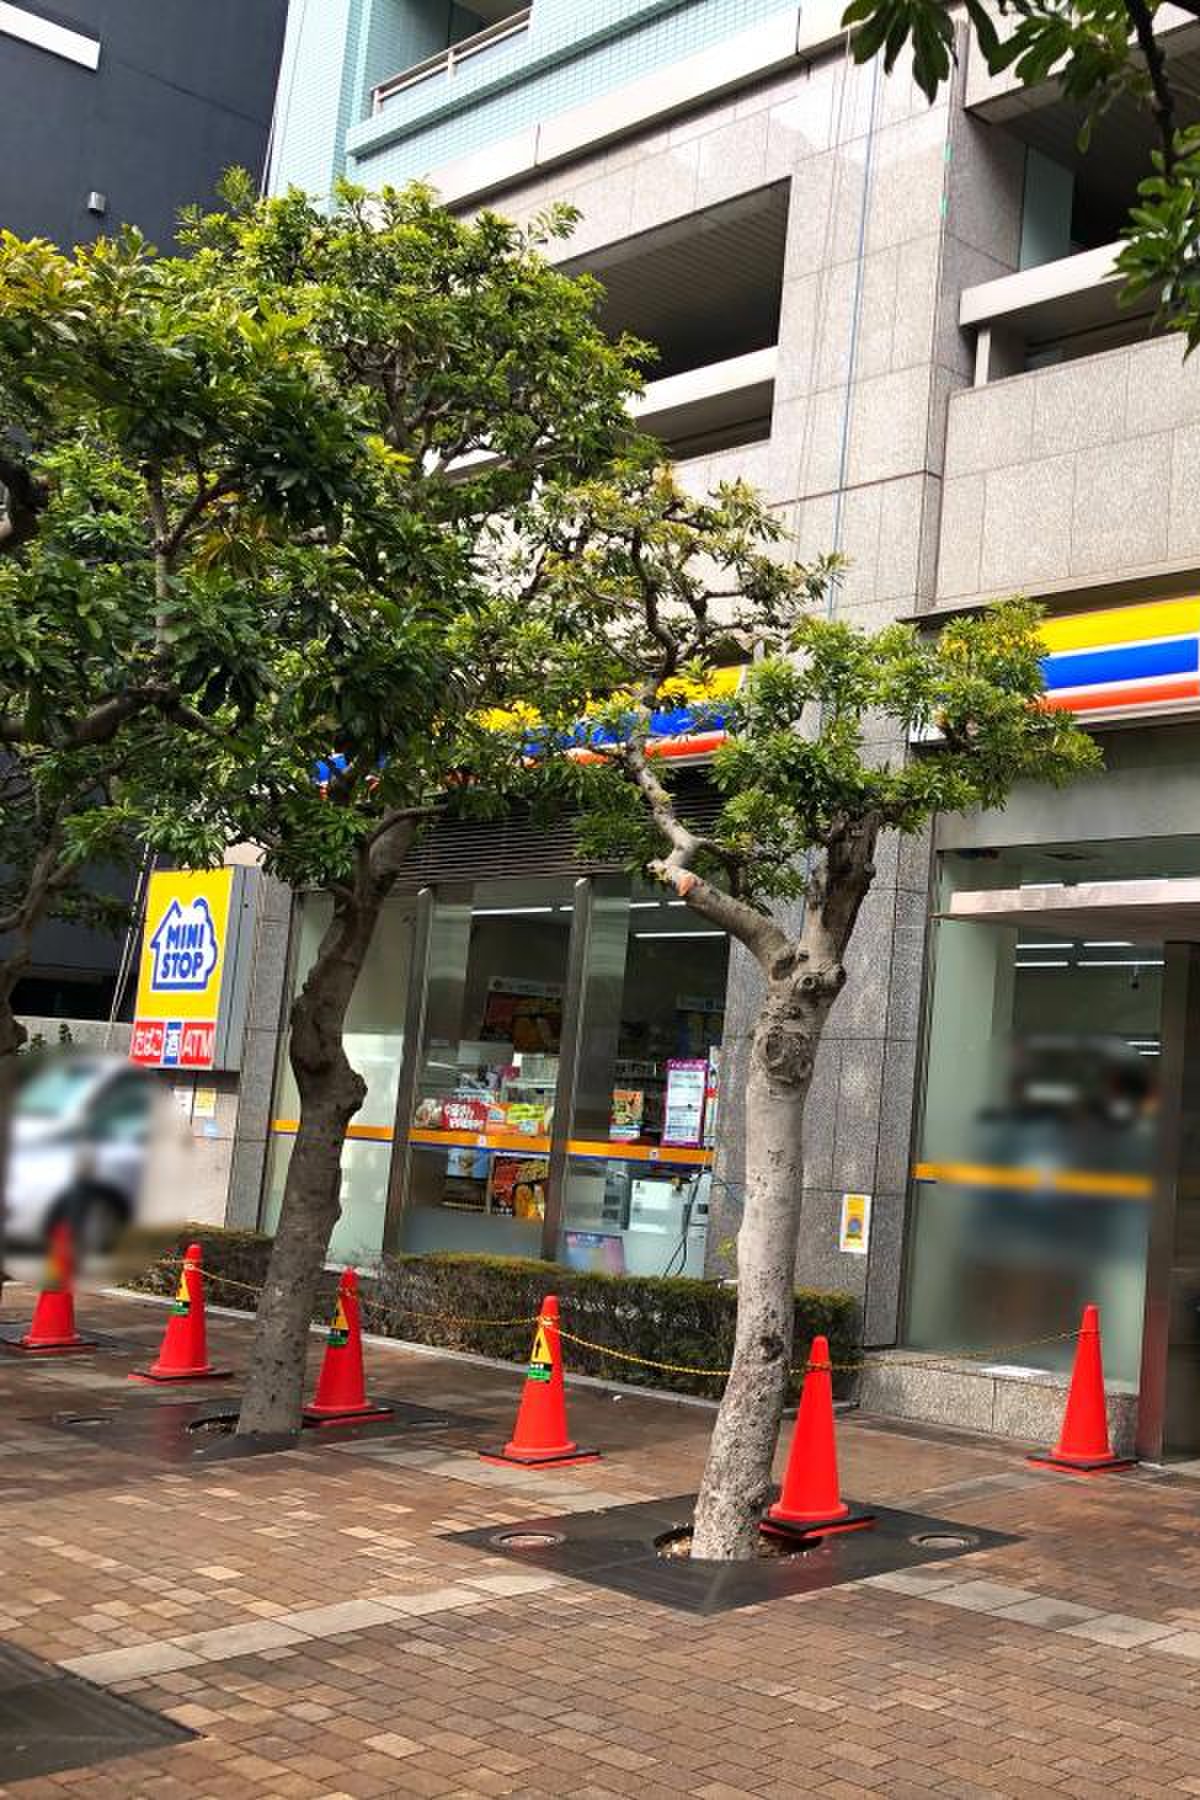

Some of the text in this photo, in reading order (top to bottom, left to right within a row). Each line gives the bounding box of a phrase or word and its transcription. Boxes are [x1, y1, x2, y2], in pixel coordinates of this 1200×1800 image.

[165, 924, 205, 949] MINI
[161, 952, 204, 979] STOP
[134, 1027, 214, 1059] たばこ 酒 ATM
